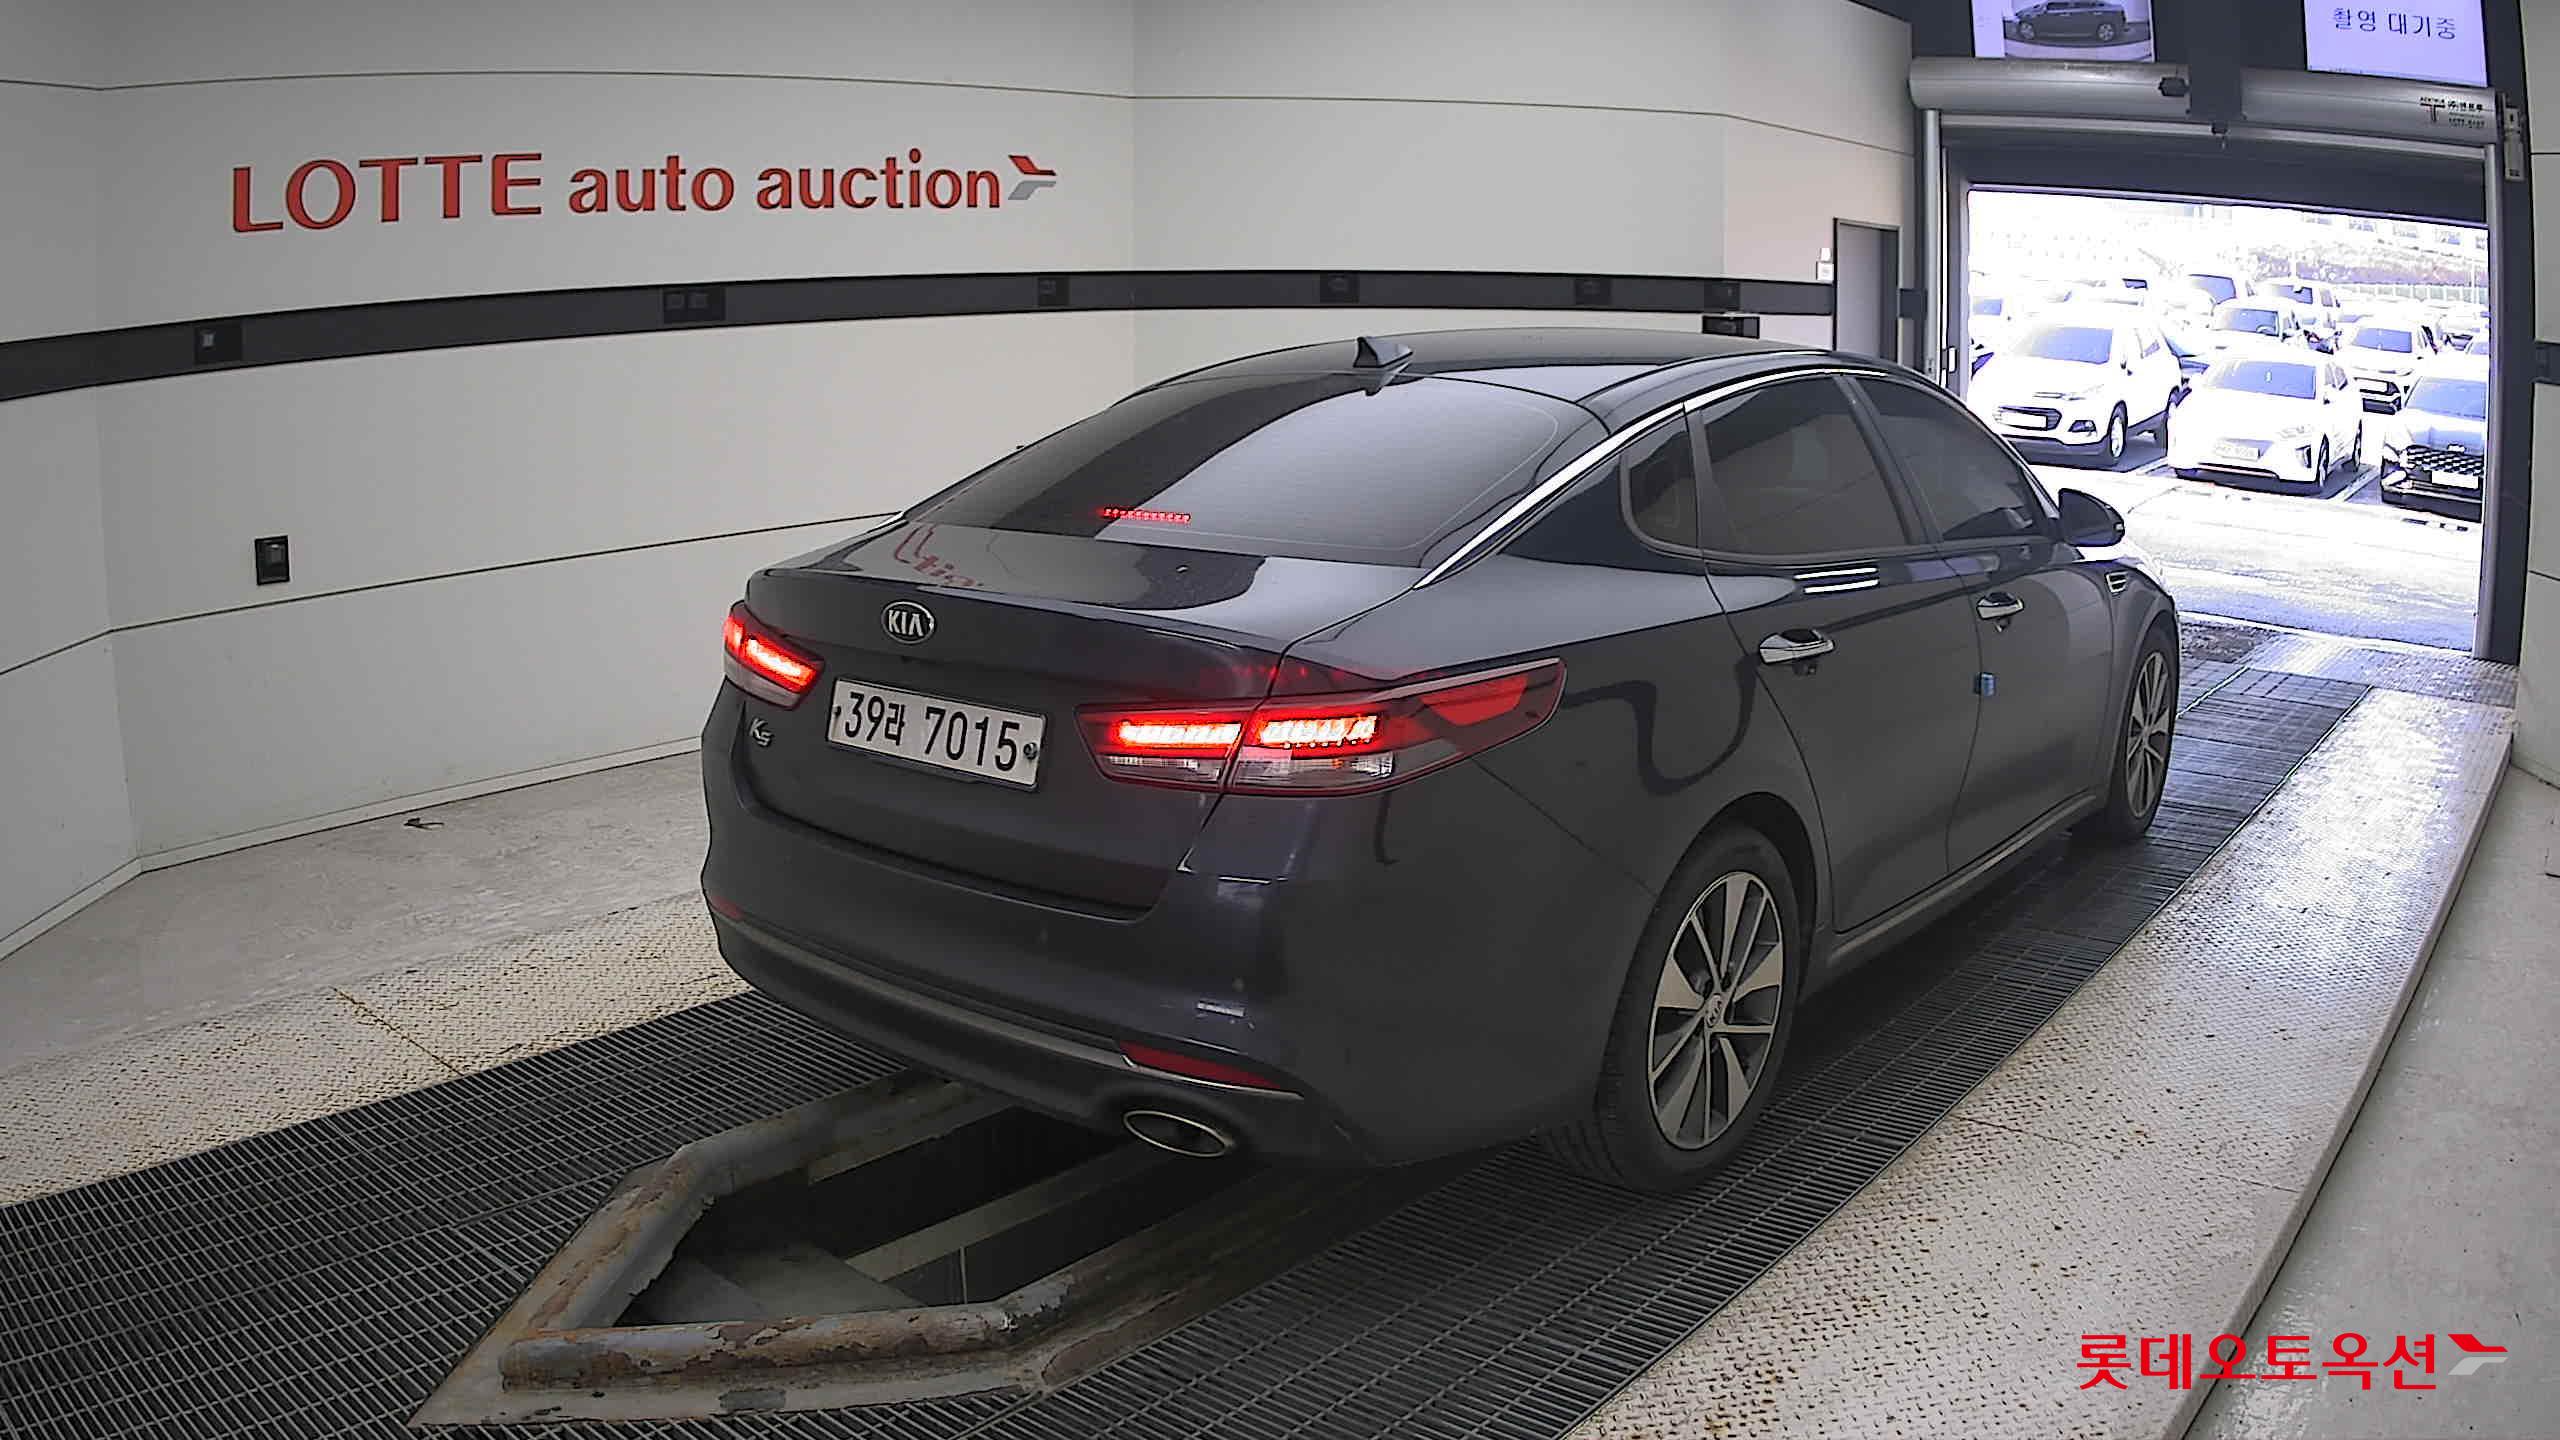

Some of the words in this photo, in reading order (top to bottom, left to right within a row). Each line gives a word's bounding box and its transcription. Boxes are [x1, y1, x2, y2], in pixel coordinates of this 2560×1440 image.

[2388, 12, 2456, 40] 대기중
[232, 153, 542, 234] LOTTE
[567, 155, 735, 214] auto
[755, 148, 1004, 210] auction
[888, 609, 925, 638] KIA
[844, 690, 905, 746] 39라
[924, 706, 1022, 772] 7015
